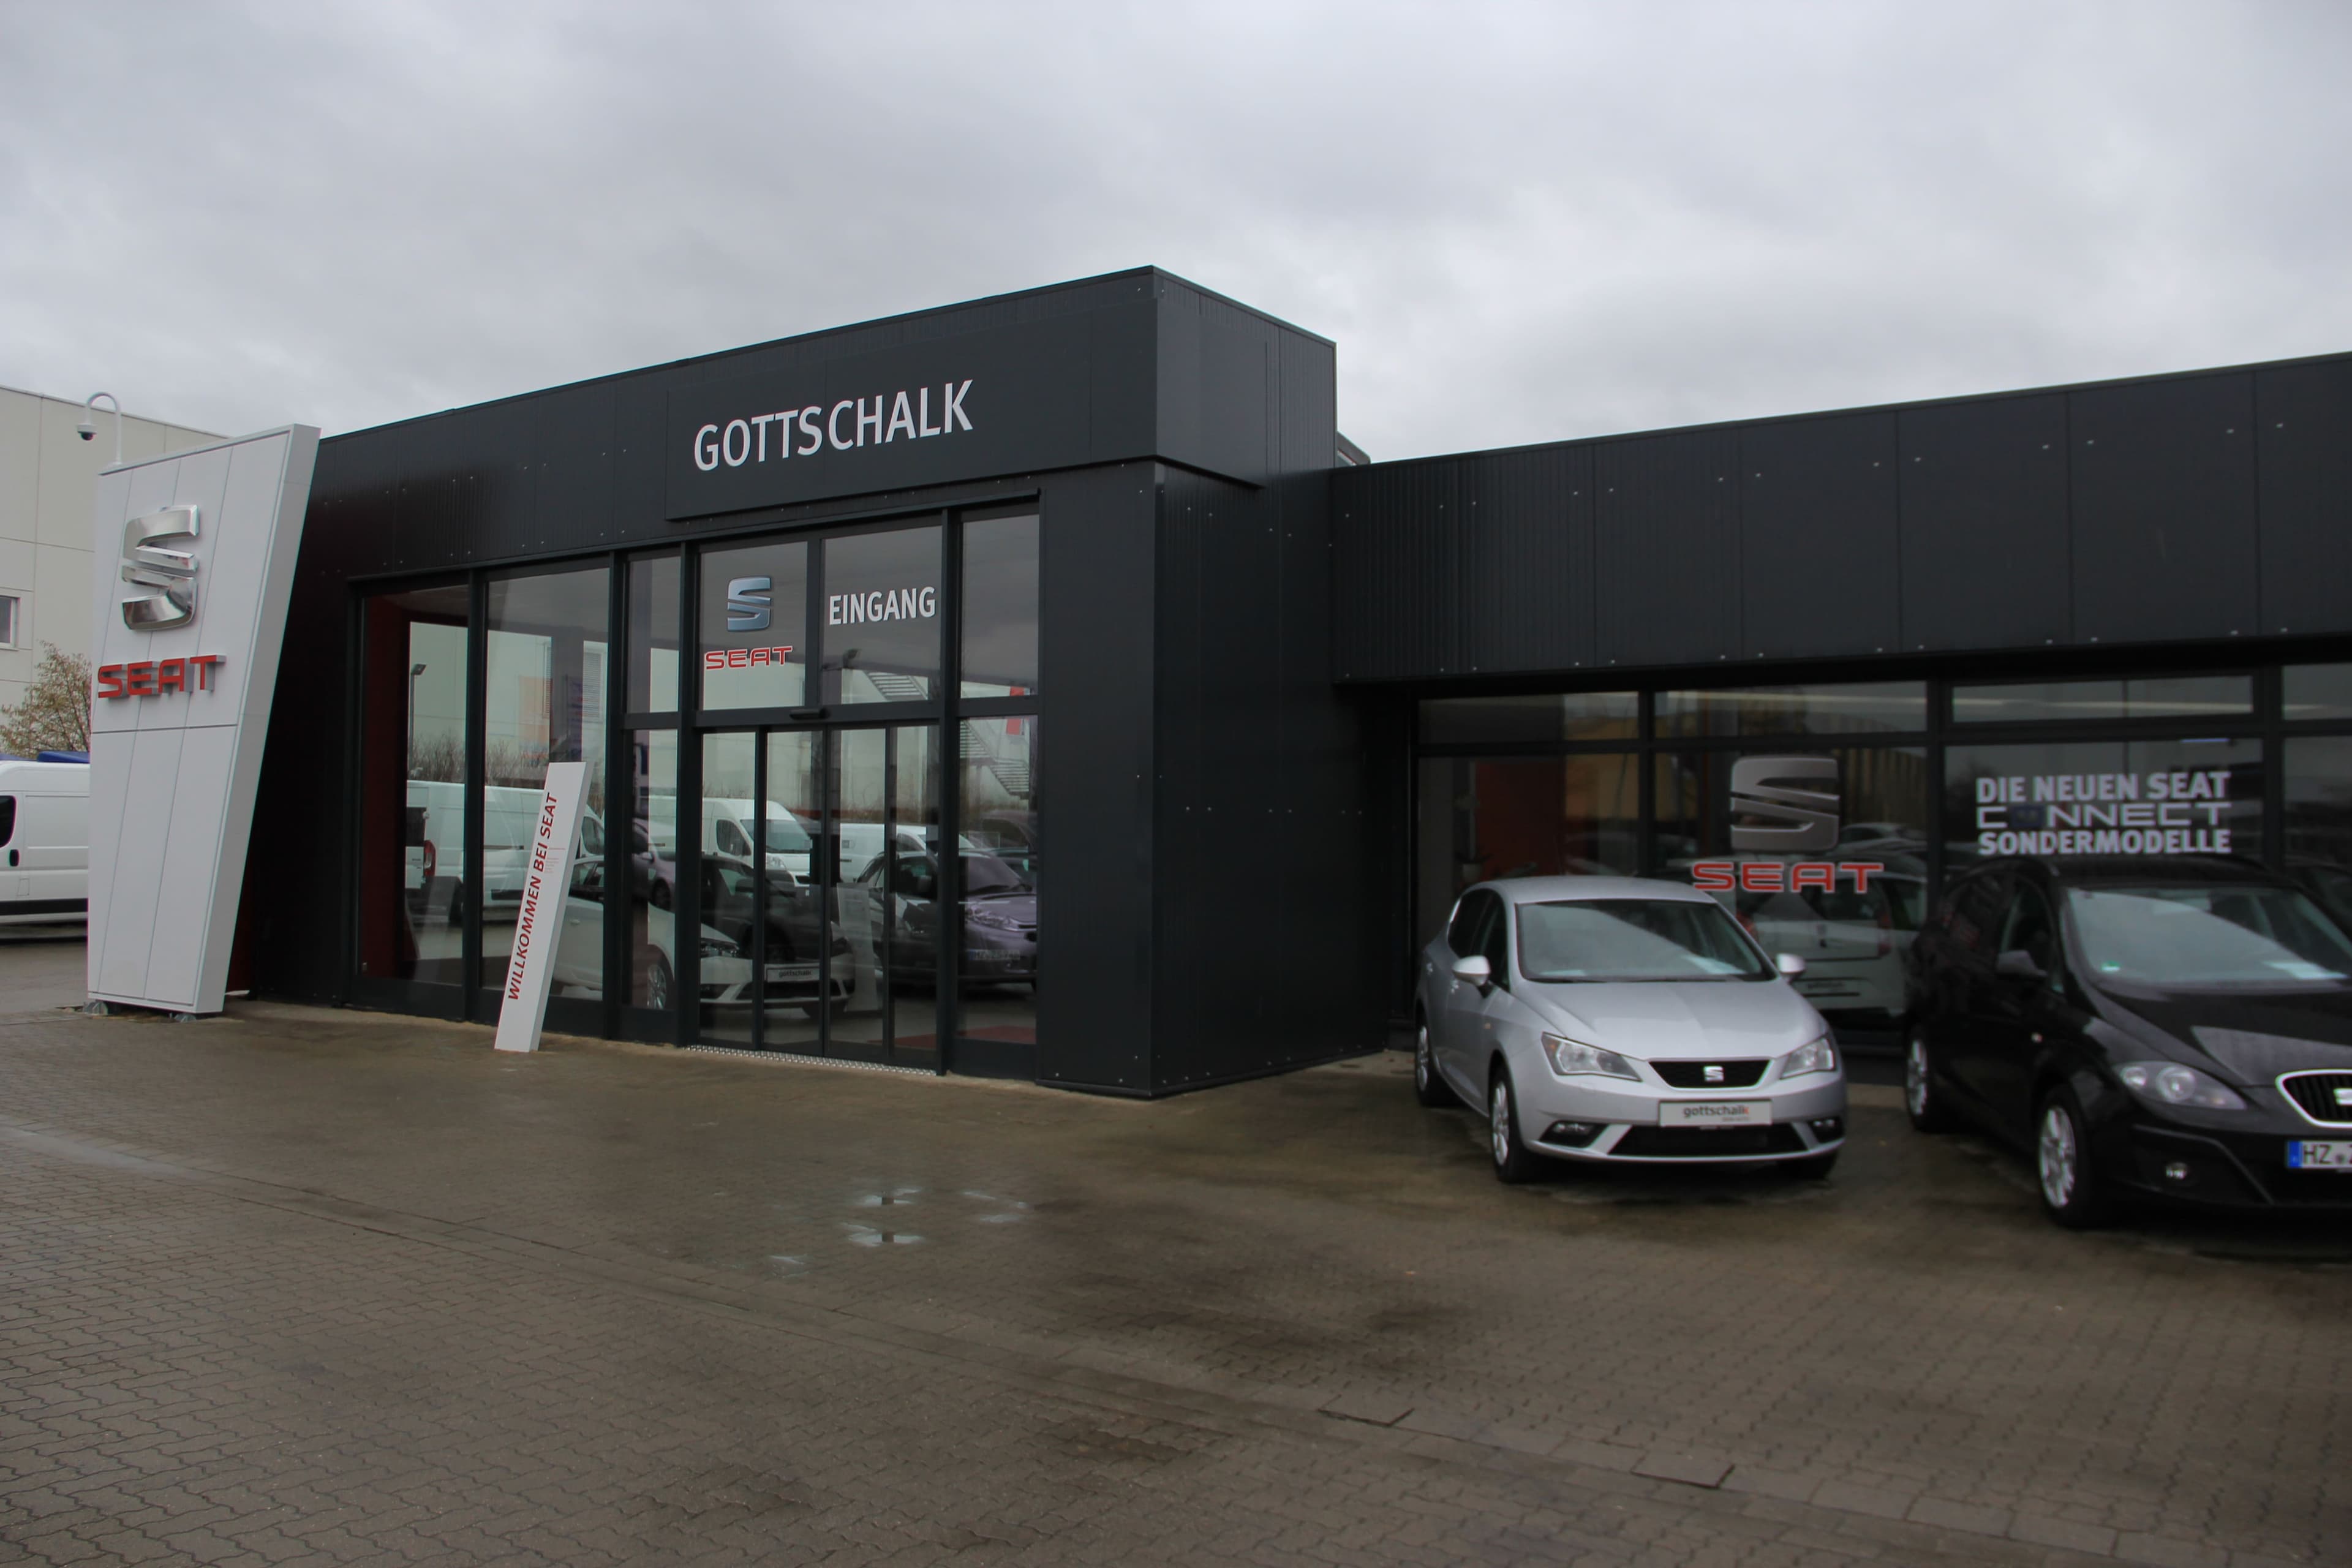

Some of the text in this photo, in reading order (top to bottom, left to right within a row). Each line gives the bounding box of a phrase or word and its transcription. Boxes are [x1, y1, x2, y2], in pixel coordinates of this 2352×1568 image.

[695, 379, 974, 471] GOTTSCHALK
[829, 586, 937, 625] EINGANG
[705, 646, 793, 670] SEAT
[97, 654, 224, 699] SEAT
[1976, 771, 2232, 803] DIE NEUEN SEAT
[540, 792, 558, 840] SEAT
[533, 842, 548, 873] BEI
[1977, 829, 2232, 856] SONDERMODELLE
[1692, 862, 1884, 894] SEAT
[508, 876, 541, 1001] WILLKOMMEN
[1683, 1105, 1749, 1118] gottschalk
